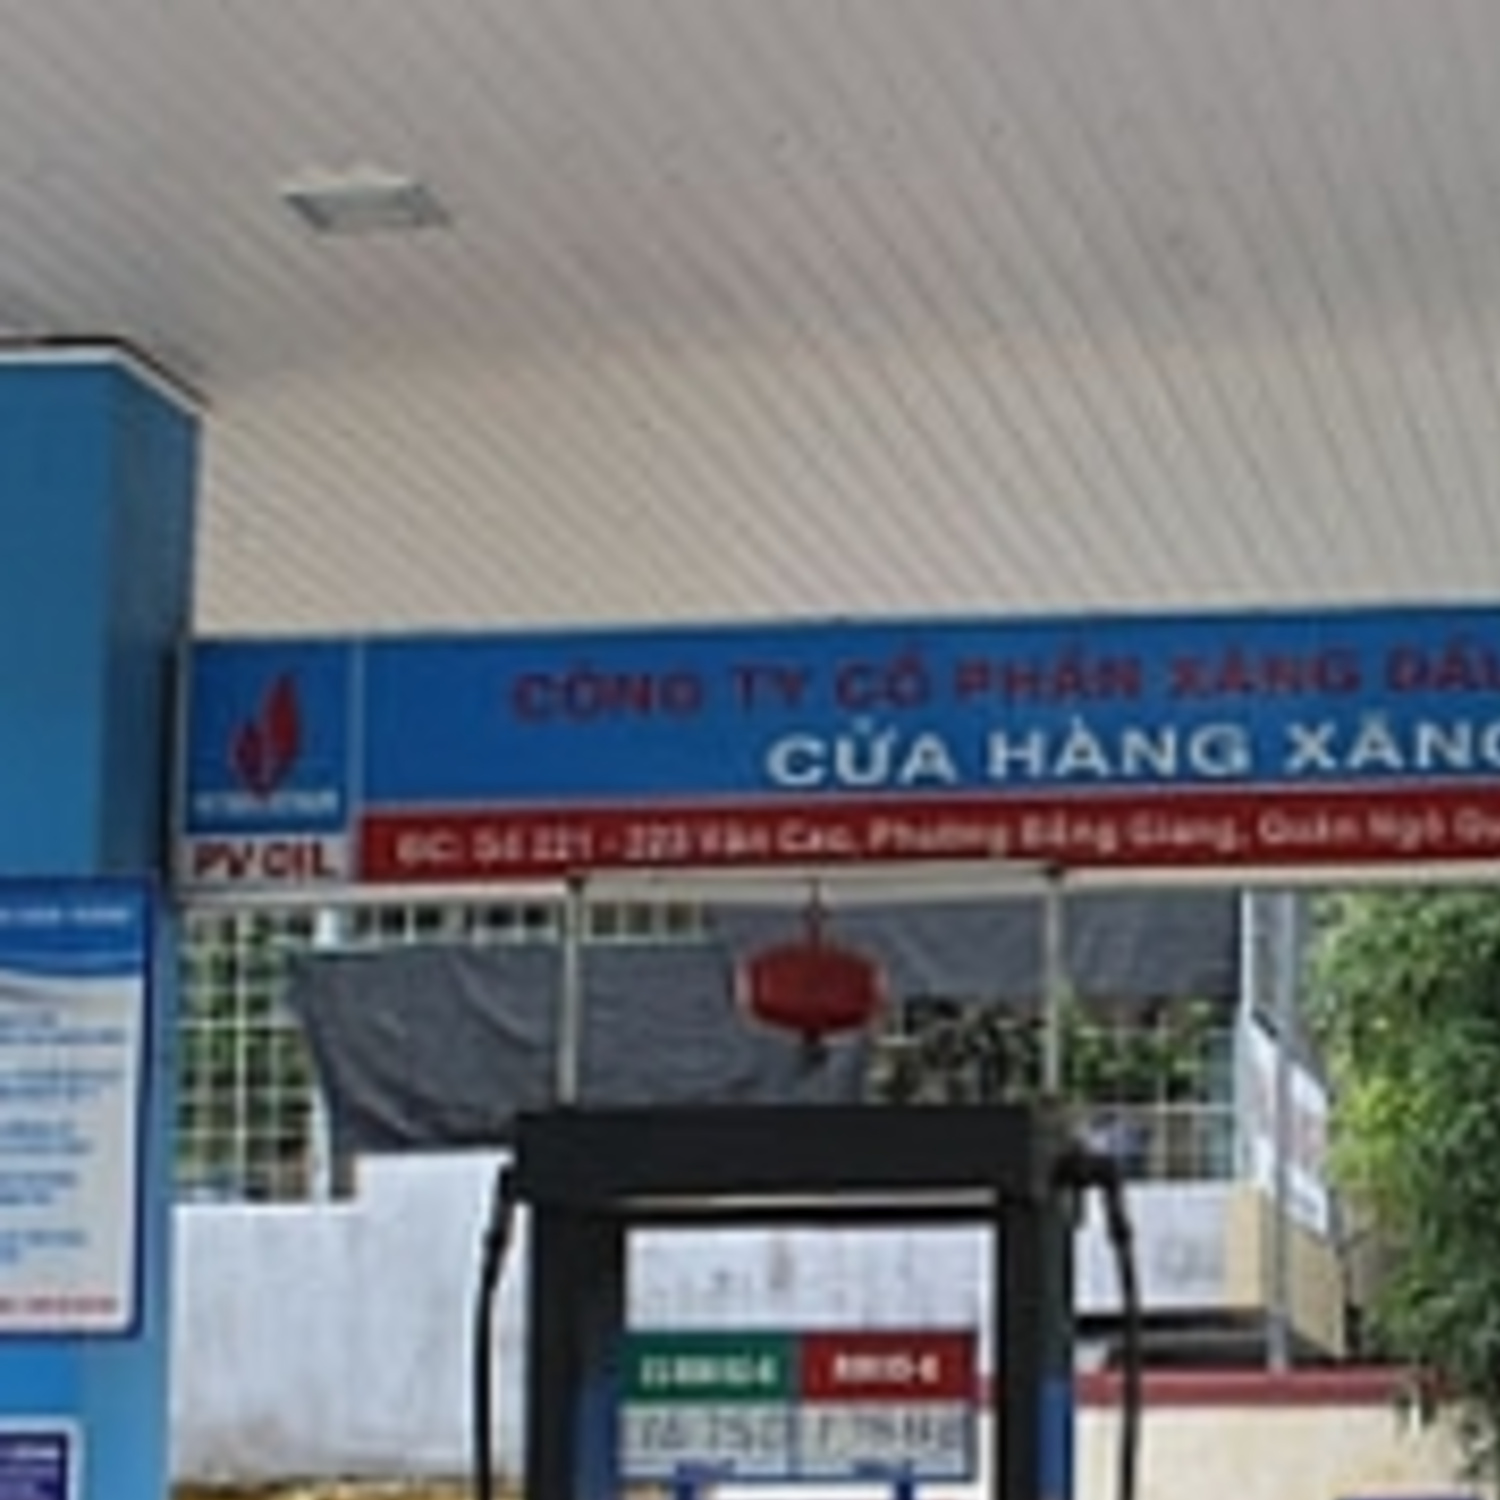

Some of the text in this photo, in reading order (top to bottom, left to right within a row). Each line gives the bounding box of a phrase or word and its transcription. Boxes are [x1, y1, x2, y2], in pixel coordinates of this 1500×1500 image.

[512, 661, 703, 722] CÔNG
[733, 661, 812, 713] TY
[767, 716, 956, 785] CỬA
[986, 716, 1250, 779] HÀNG
[194, 838, 339, 878] PV OIL
